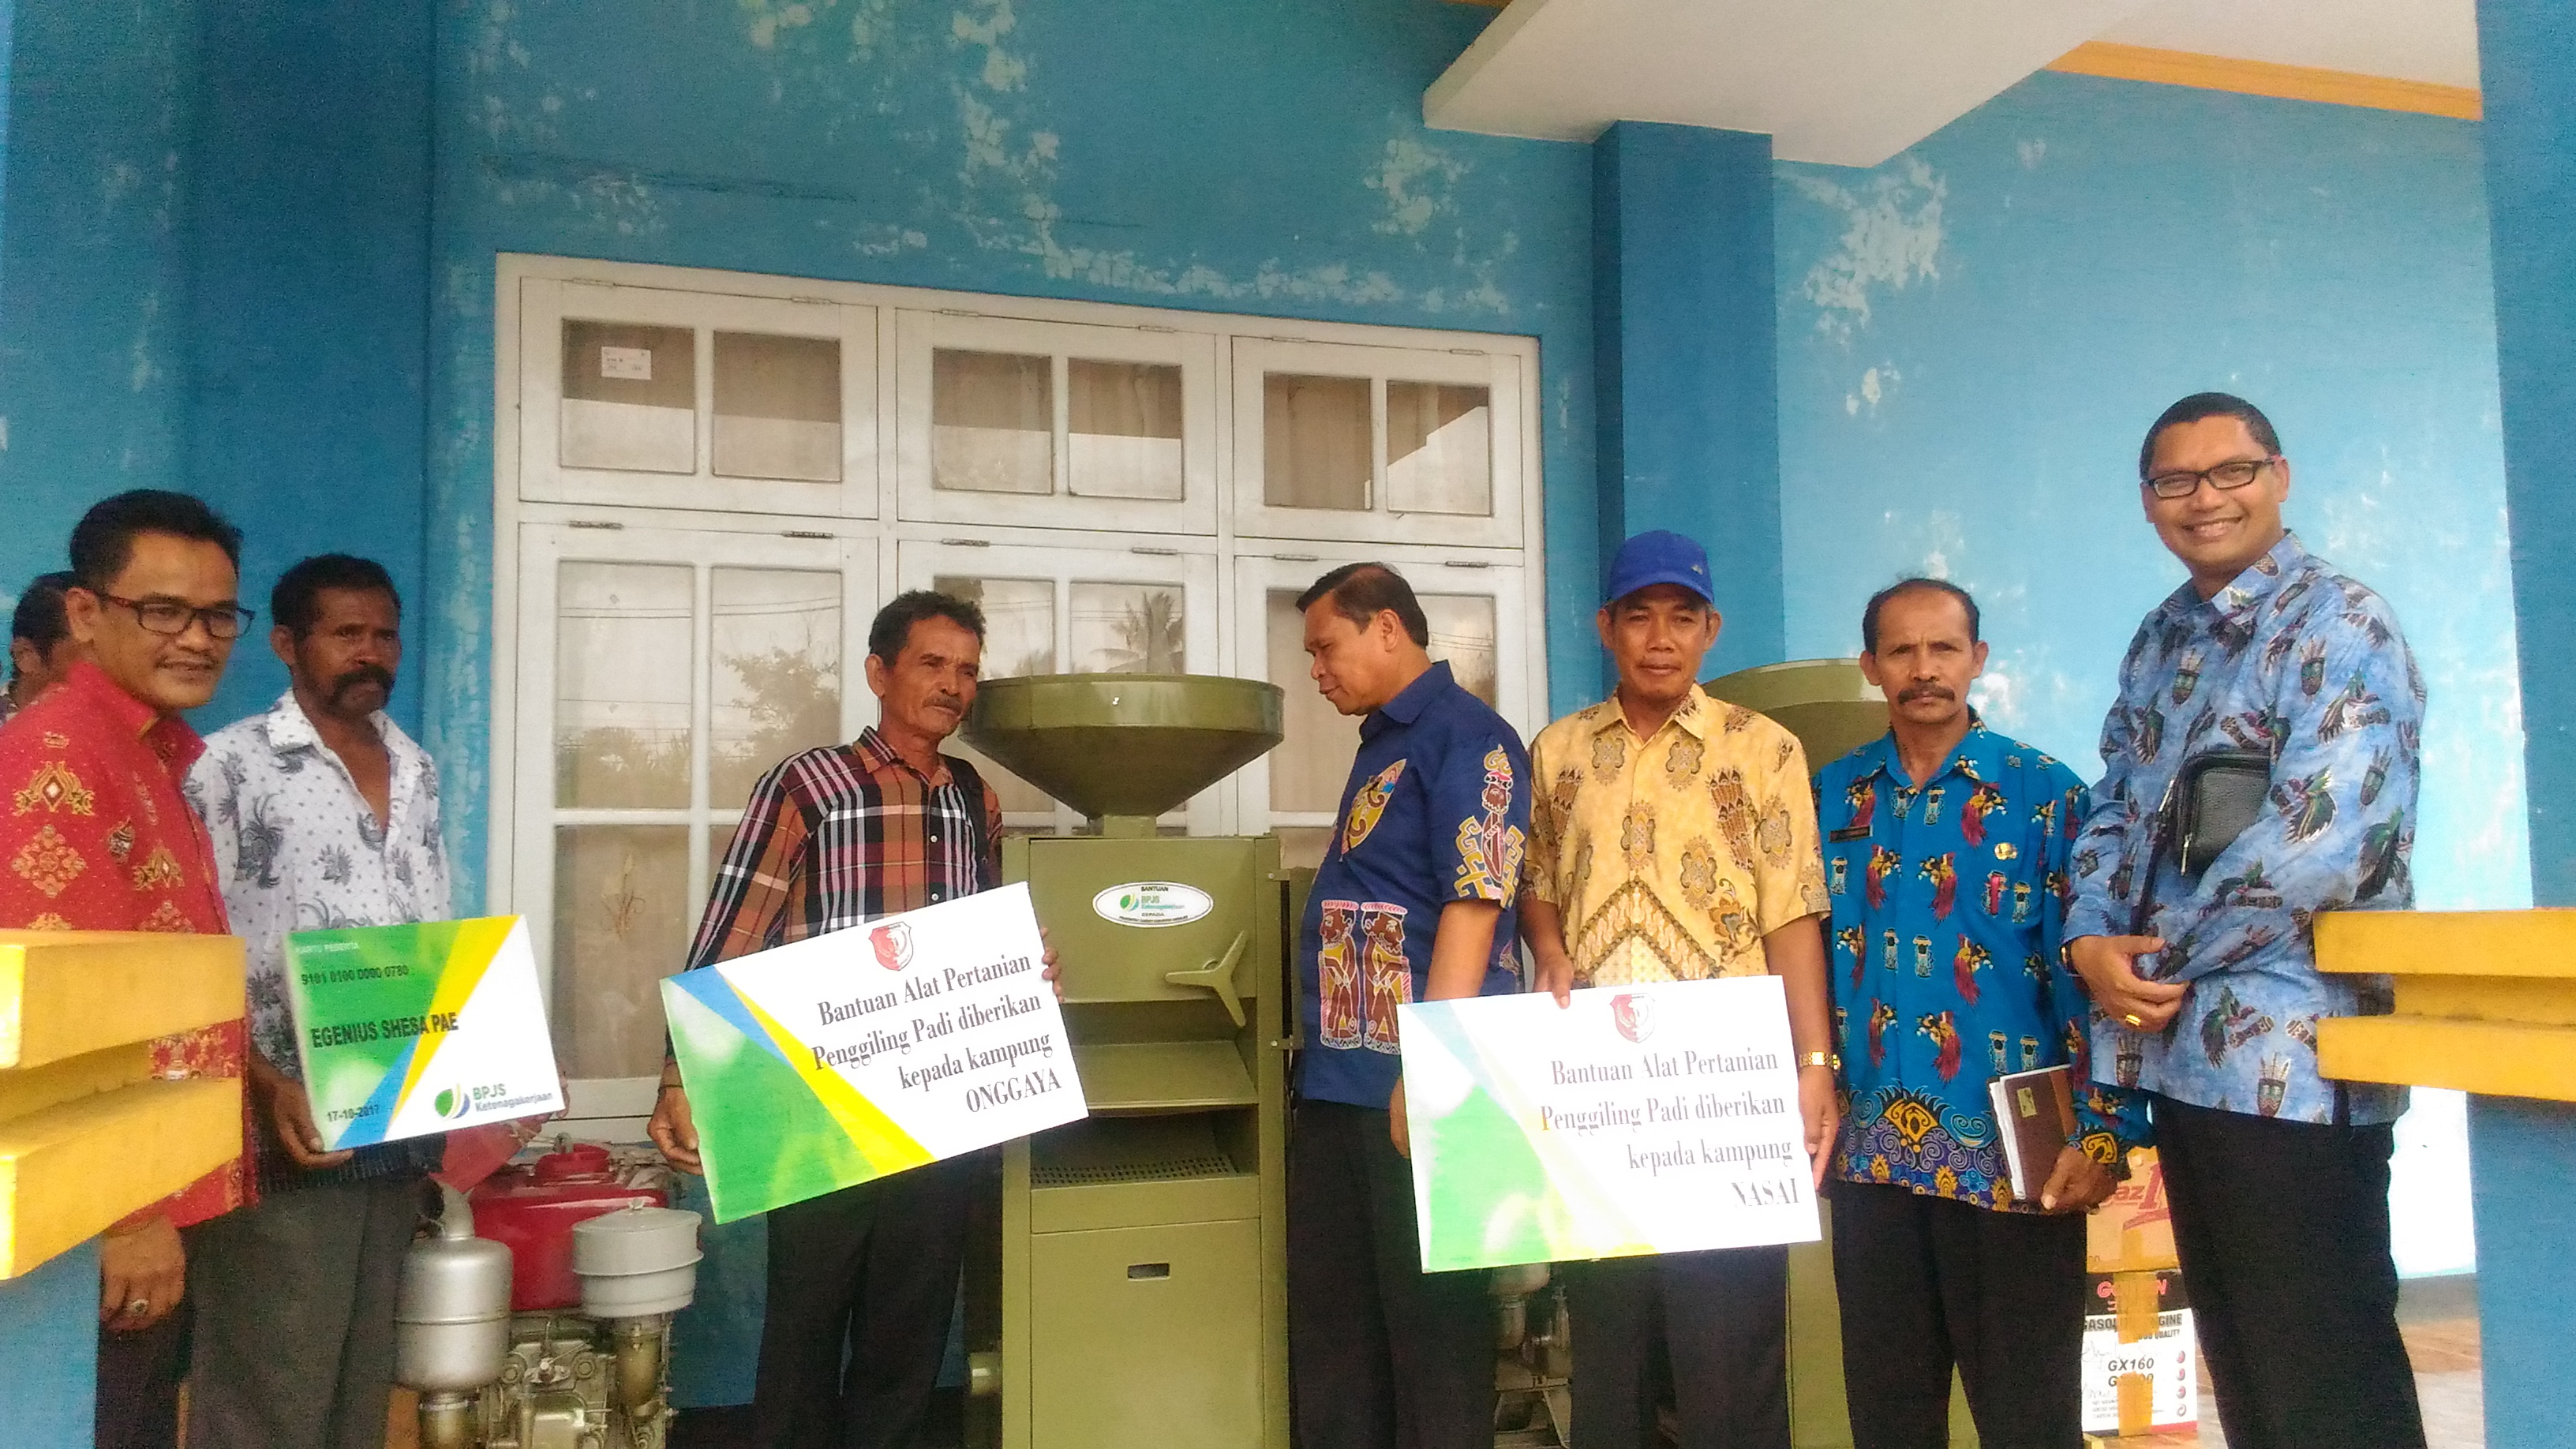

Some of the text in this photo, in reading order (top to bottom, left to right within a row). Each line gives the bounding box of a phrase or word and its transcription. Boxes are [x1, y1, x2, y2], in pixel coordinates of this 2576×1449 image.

[818, 954, 1032, 1026] Bantuan Alat Pertanian
[311, 1012, 459, 1049] EGENIUS SHESA PAE
[811, 994, 1042, 1070] Penggiling Padi diberikan
[898, 1033, 1054, 1092] kepada kampung
[1551, 1047, 1779, 1085] Bantuan Alat Pertanian
[473, 1083, 507, 1100] BPJS
[966, 1068, 1062, 1113] ONGGAYA
[1541, 1091, 1786, 1136] Penggiling Padi diberikan
[1627, 1139, 1793, 1177] kepada kampung
[1732, 1178, 1799, 1208] NASAI
[2108, 1357, 2155, 1372] GX160
